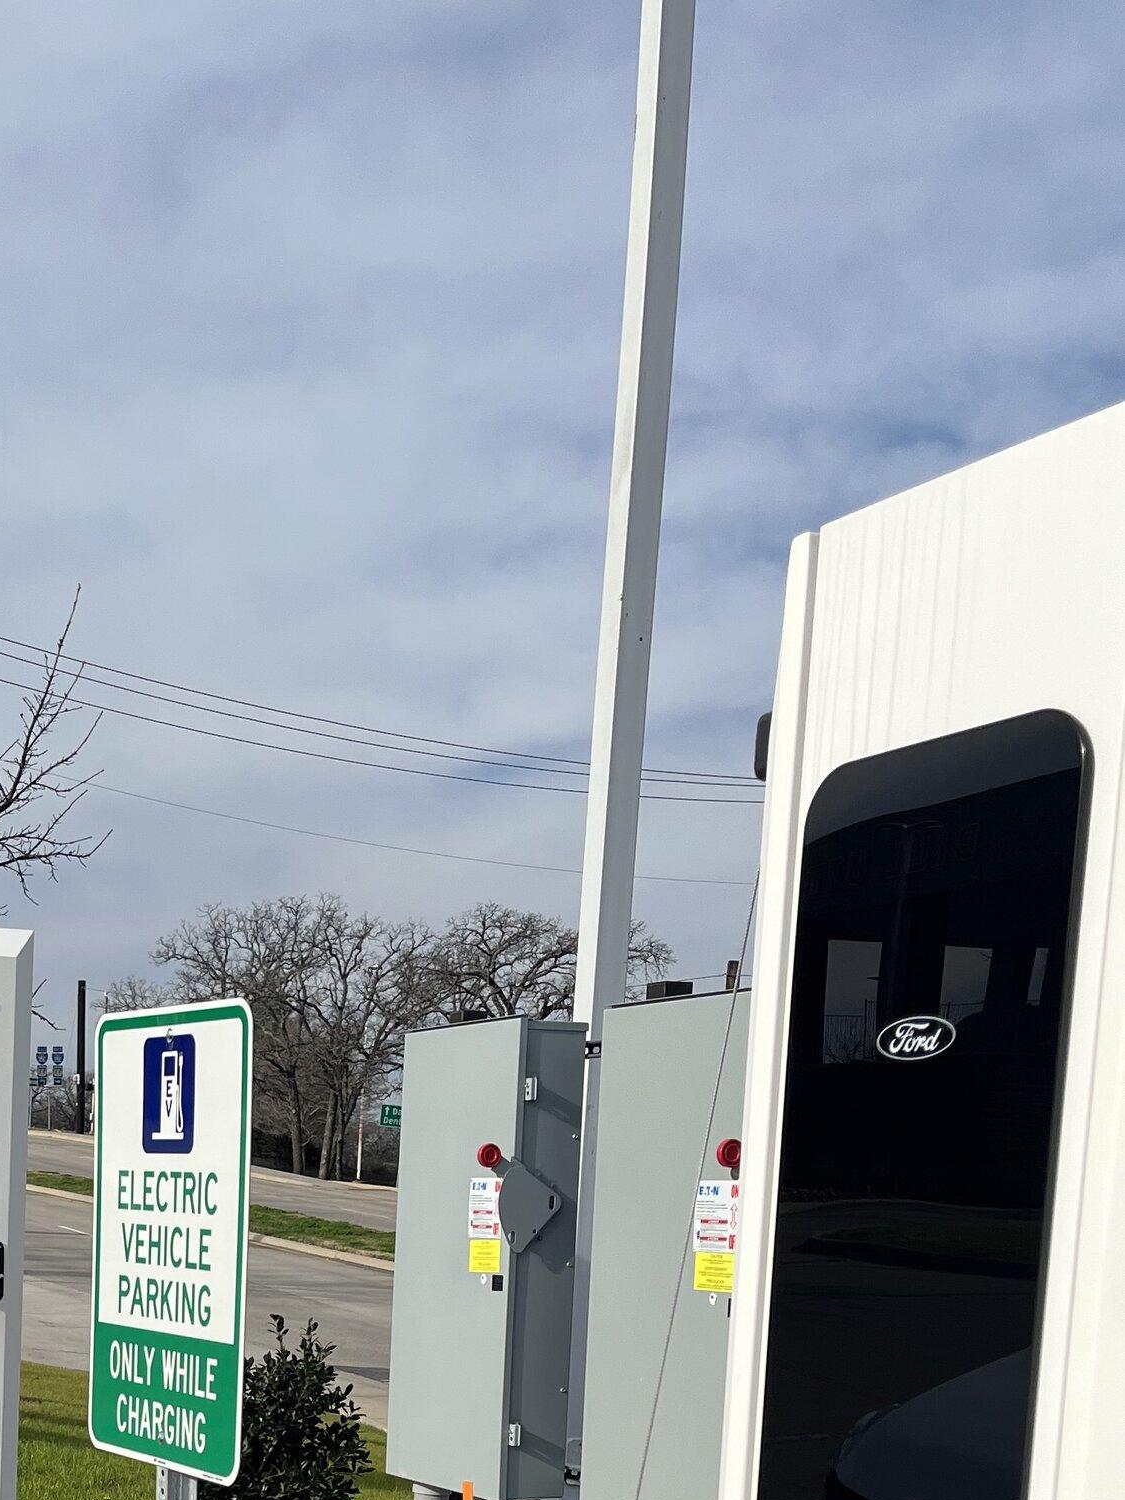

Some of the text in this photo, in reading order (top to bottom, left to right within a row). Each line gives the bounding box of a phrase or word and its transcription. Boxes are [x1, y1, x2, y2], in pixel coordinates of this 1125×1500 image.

[888, 1022, 942, 1053] Ford
[117, 1170, 219, 1216] ELECTRIC
[122, 1222, 212, 1272] VEHICLE
[117, 1274, 212, 1328] PARKING
[109, 1340, 218, 1401] ONLY WHILE
[116, 1392, 207, 1454] CHARGING
